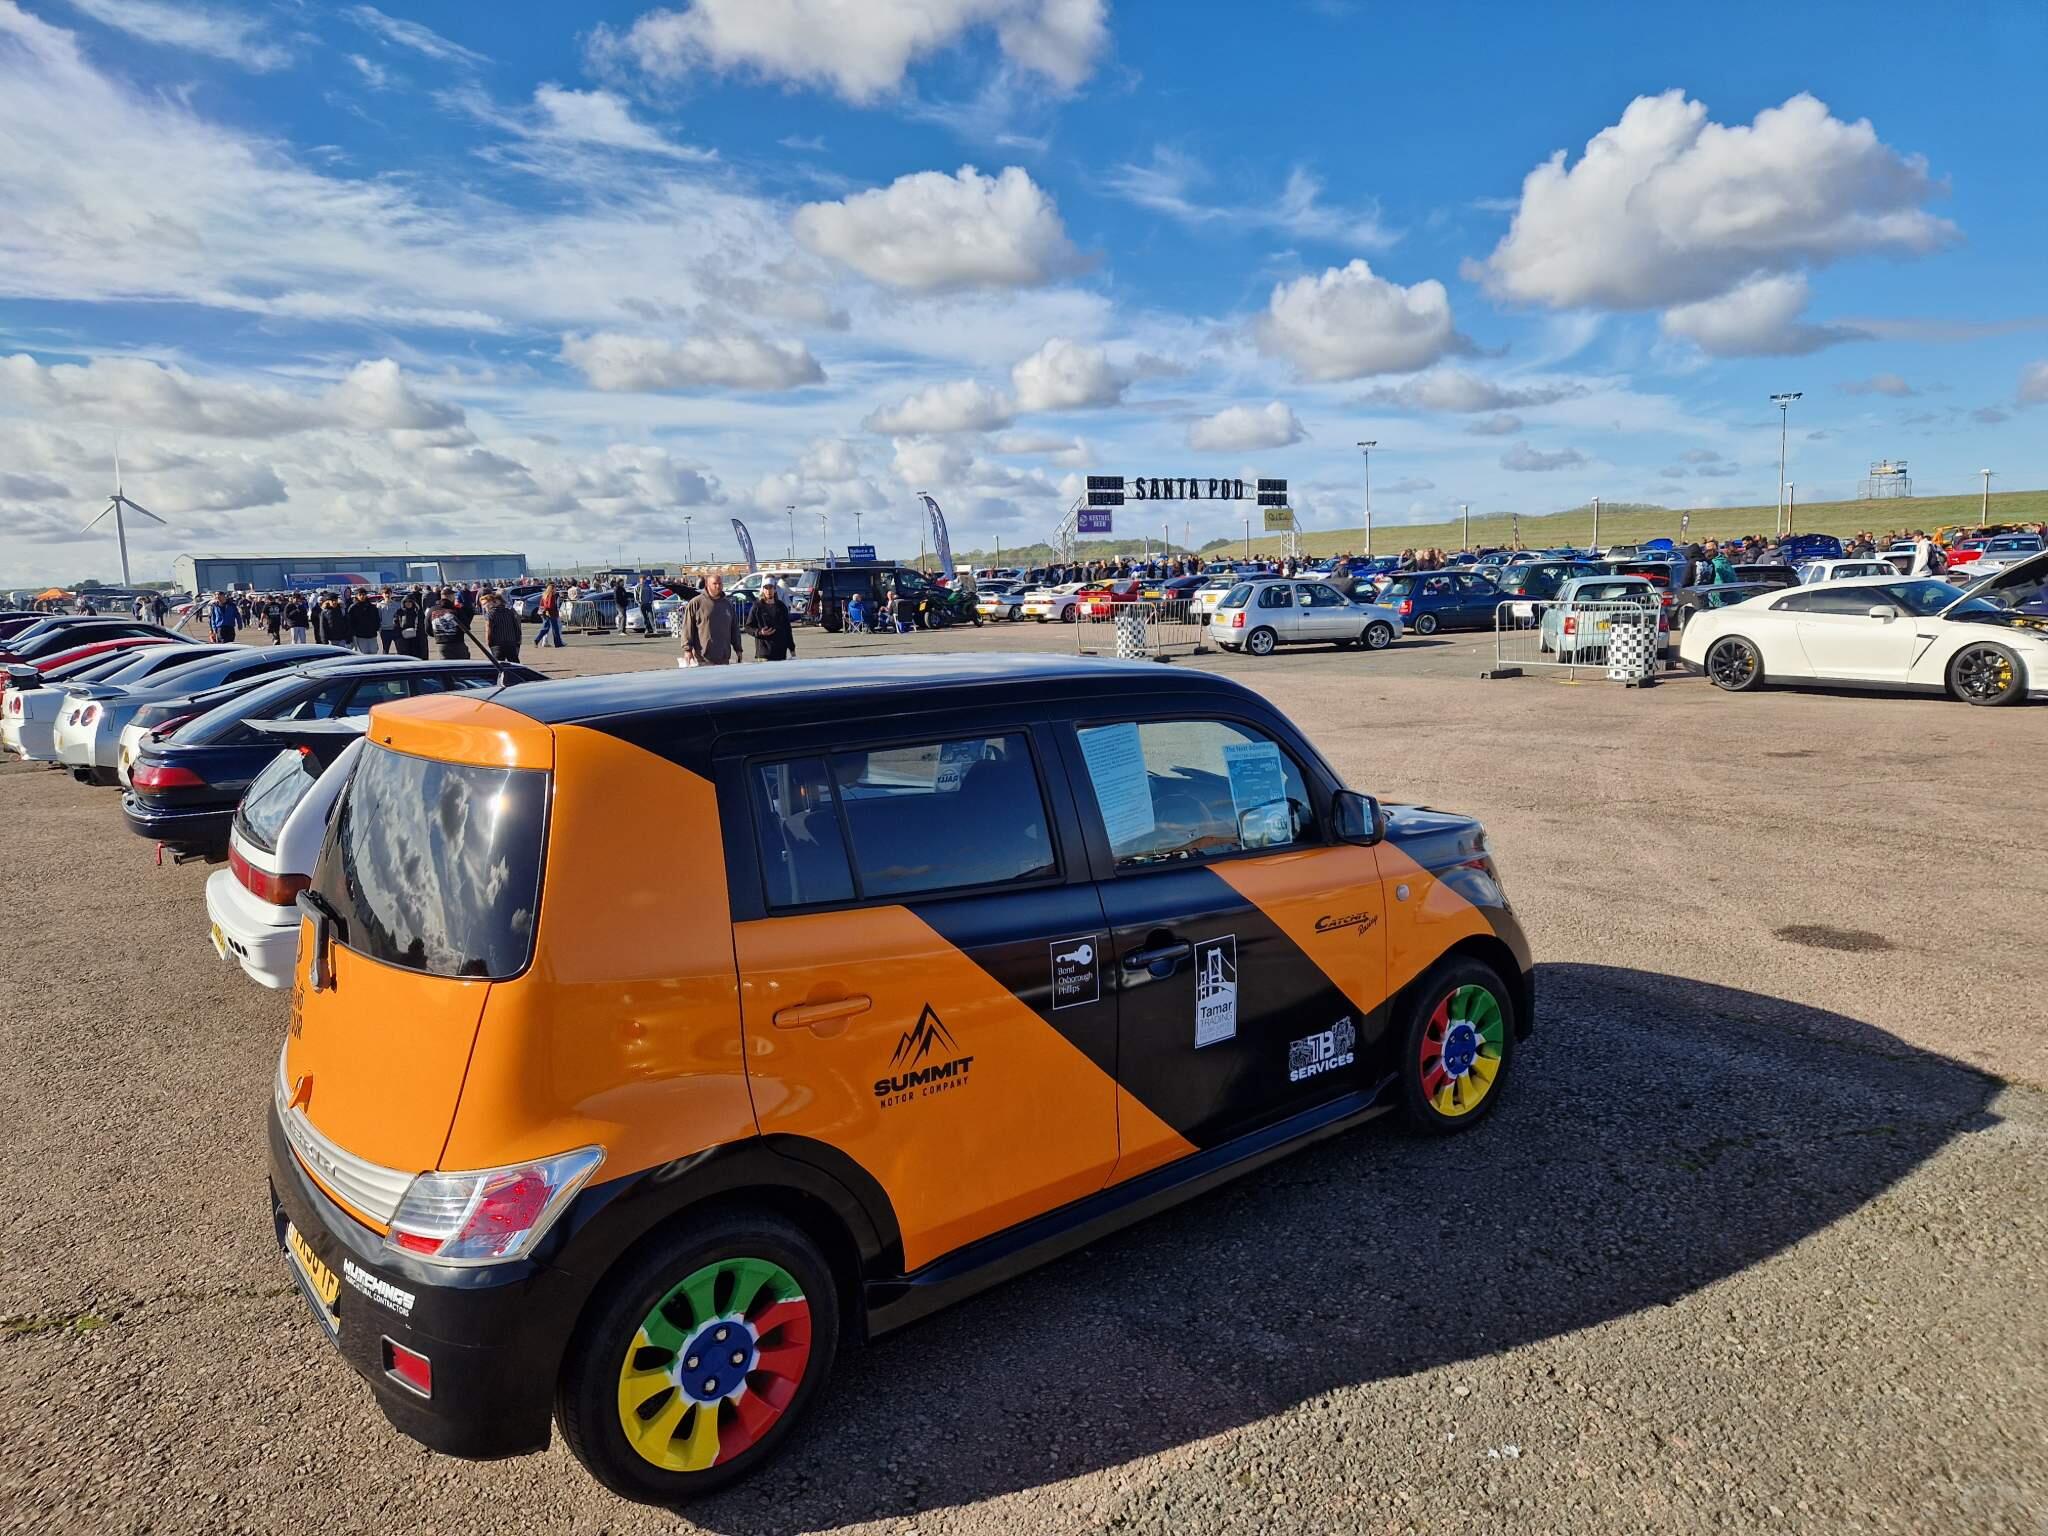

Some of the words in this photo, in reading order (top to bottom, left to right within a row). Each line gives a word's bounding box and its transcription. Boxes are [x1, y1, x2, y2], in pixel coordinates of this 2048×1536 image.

[1136, 477, 1199, 500] SANTA
[1209, 478, 1244, 500] POD
[1058, 963, 1075, 975] Bond
[1058, 971, 1093, 985] Oxborough
[1058, 984, 1080, 996] Phillips
[1200, 1001, 1233, 1018] Tamar
[874, 1056, 974, 1097] SUMMIT
[1290, 1052, 1354, 1082] SERVICES
[880, 1091, 914, 1109] MOTOR
[922, 1075, 969, 1096] COMPANY
[343, 1257, 416, 1310] HUTCHINGS
[373, 1293, 410, 1317] CONTRACTORS
